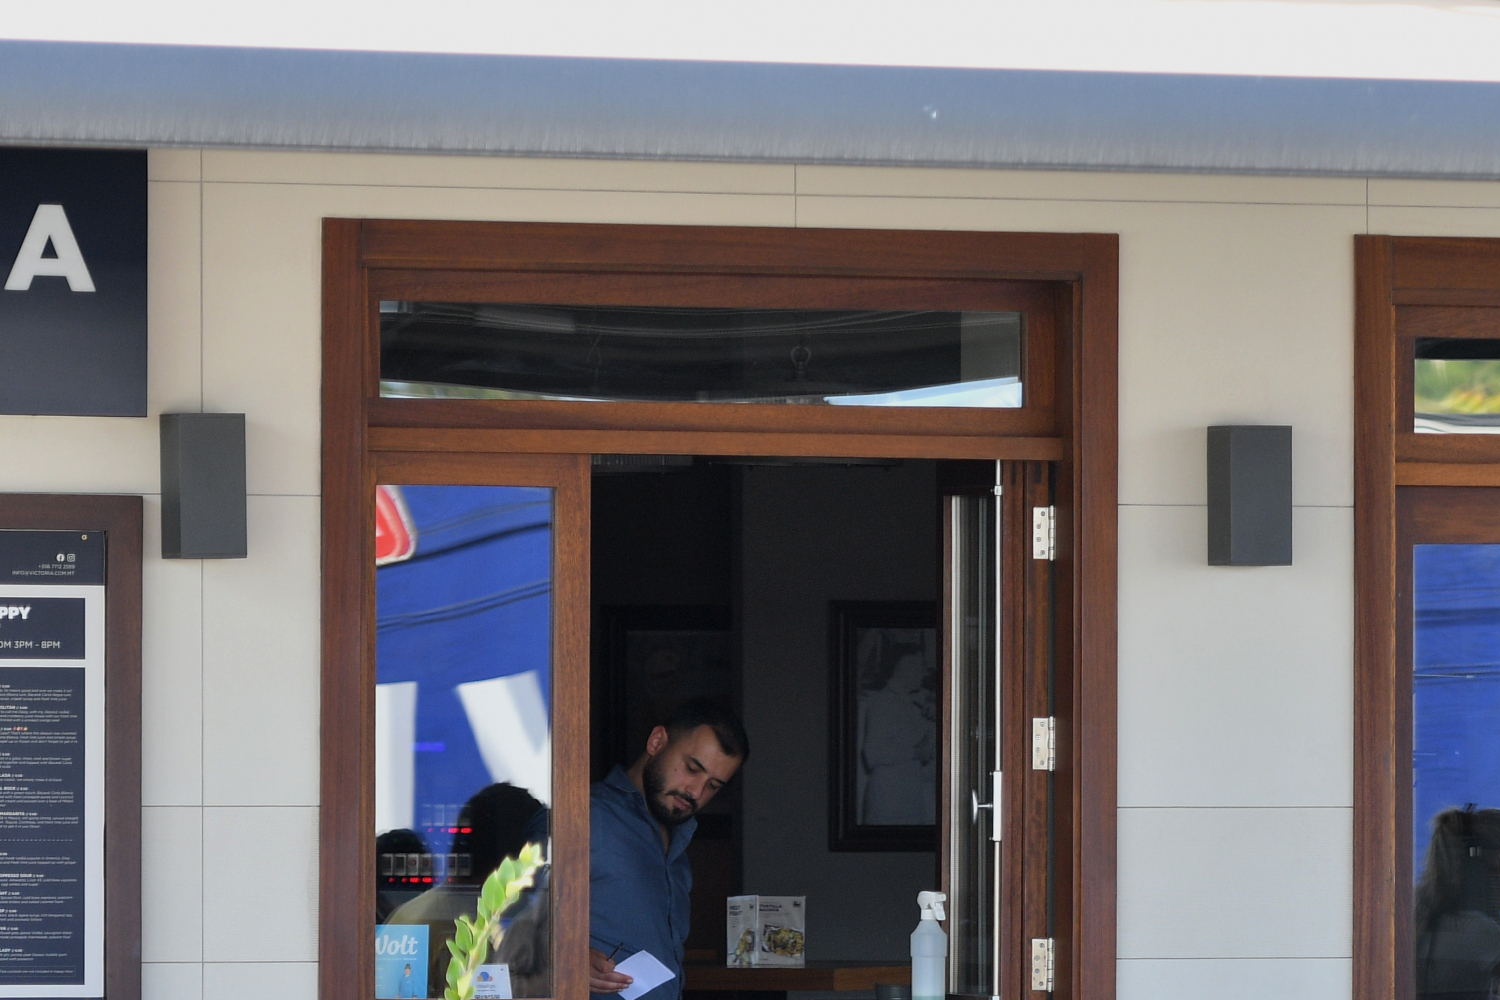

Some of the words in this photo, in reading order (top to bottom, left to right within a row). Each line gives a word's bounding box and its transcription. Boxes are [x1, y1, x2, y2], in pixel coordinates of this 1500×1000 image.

[4, 204, 96, 292] A
[14, 640, 33, 650] 3PM
[41, 640, 60, 650] 8PM
